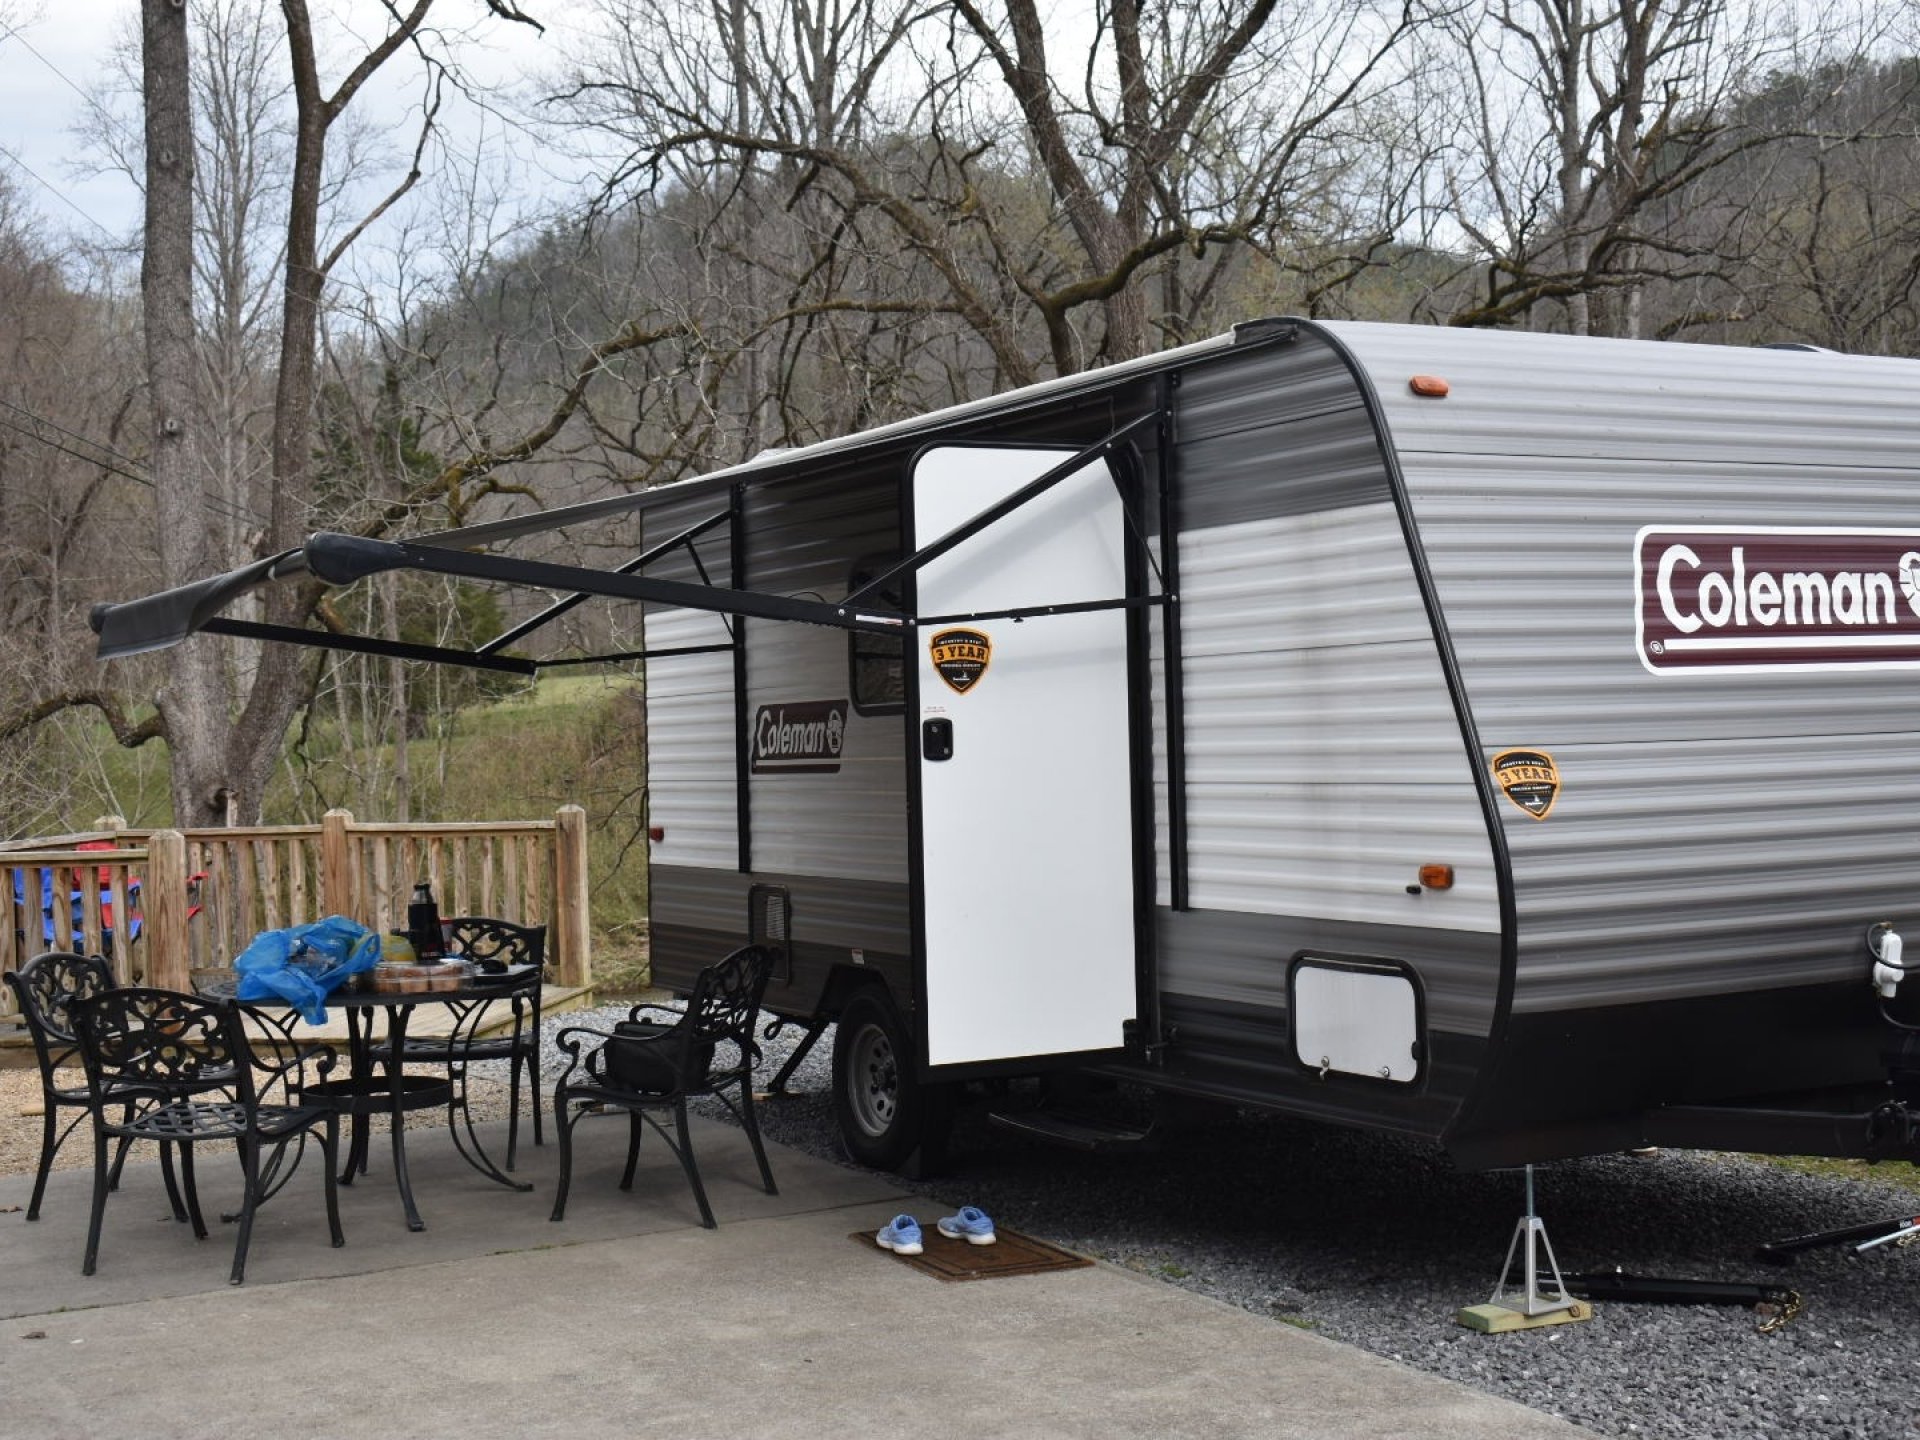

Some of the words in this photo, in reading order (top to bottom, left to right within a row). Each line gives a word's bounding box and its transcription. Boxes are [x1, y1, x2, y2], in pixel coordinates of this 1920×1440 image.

[1656, 544, 1897, 633] Coleman
[936, 649, 944, 660] 3
[948, 645, 985, 660] YEAR
[757, 709, 826, 758] Coleman
[1500, 772, 1511, 783] 3
[1512, 768, 1553, 780] YEAR
